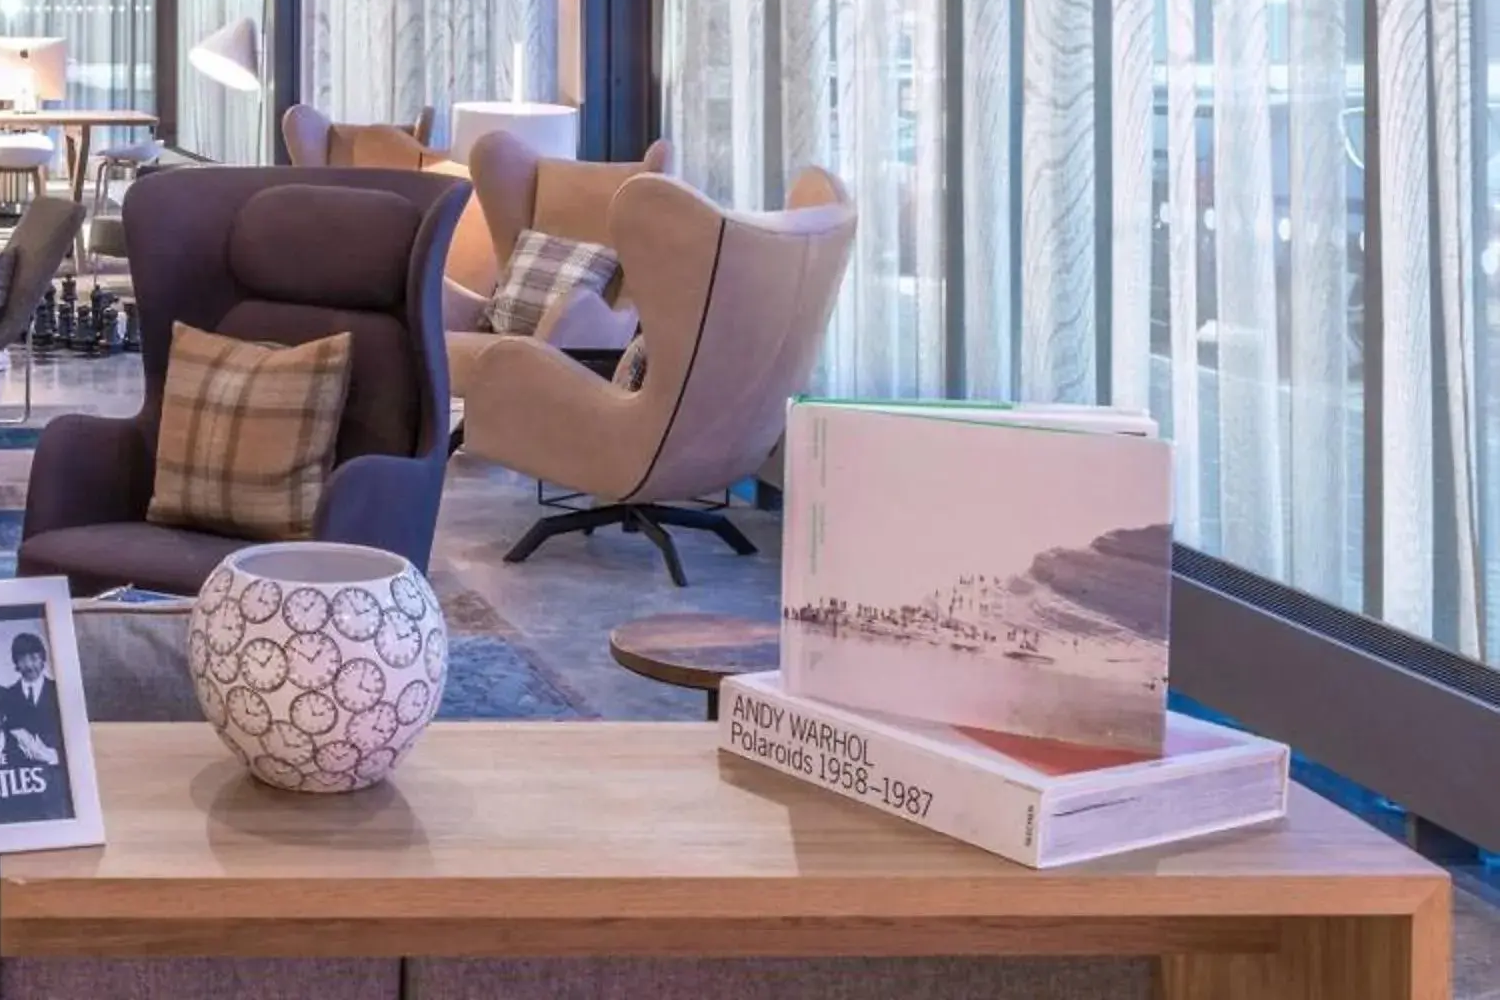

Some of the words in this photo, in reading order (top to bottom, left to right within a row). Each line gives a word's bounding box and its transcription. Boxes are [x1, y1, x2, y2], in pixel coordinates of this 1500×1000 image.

[731, 721, 814, 775] Polaroids
[819, 753, 934, 819] 1958-1987
[732, 695, 785, 733] ANDY
[789, 711, 876, 769] WARHOL
